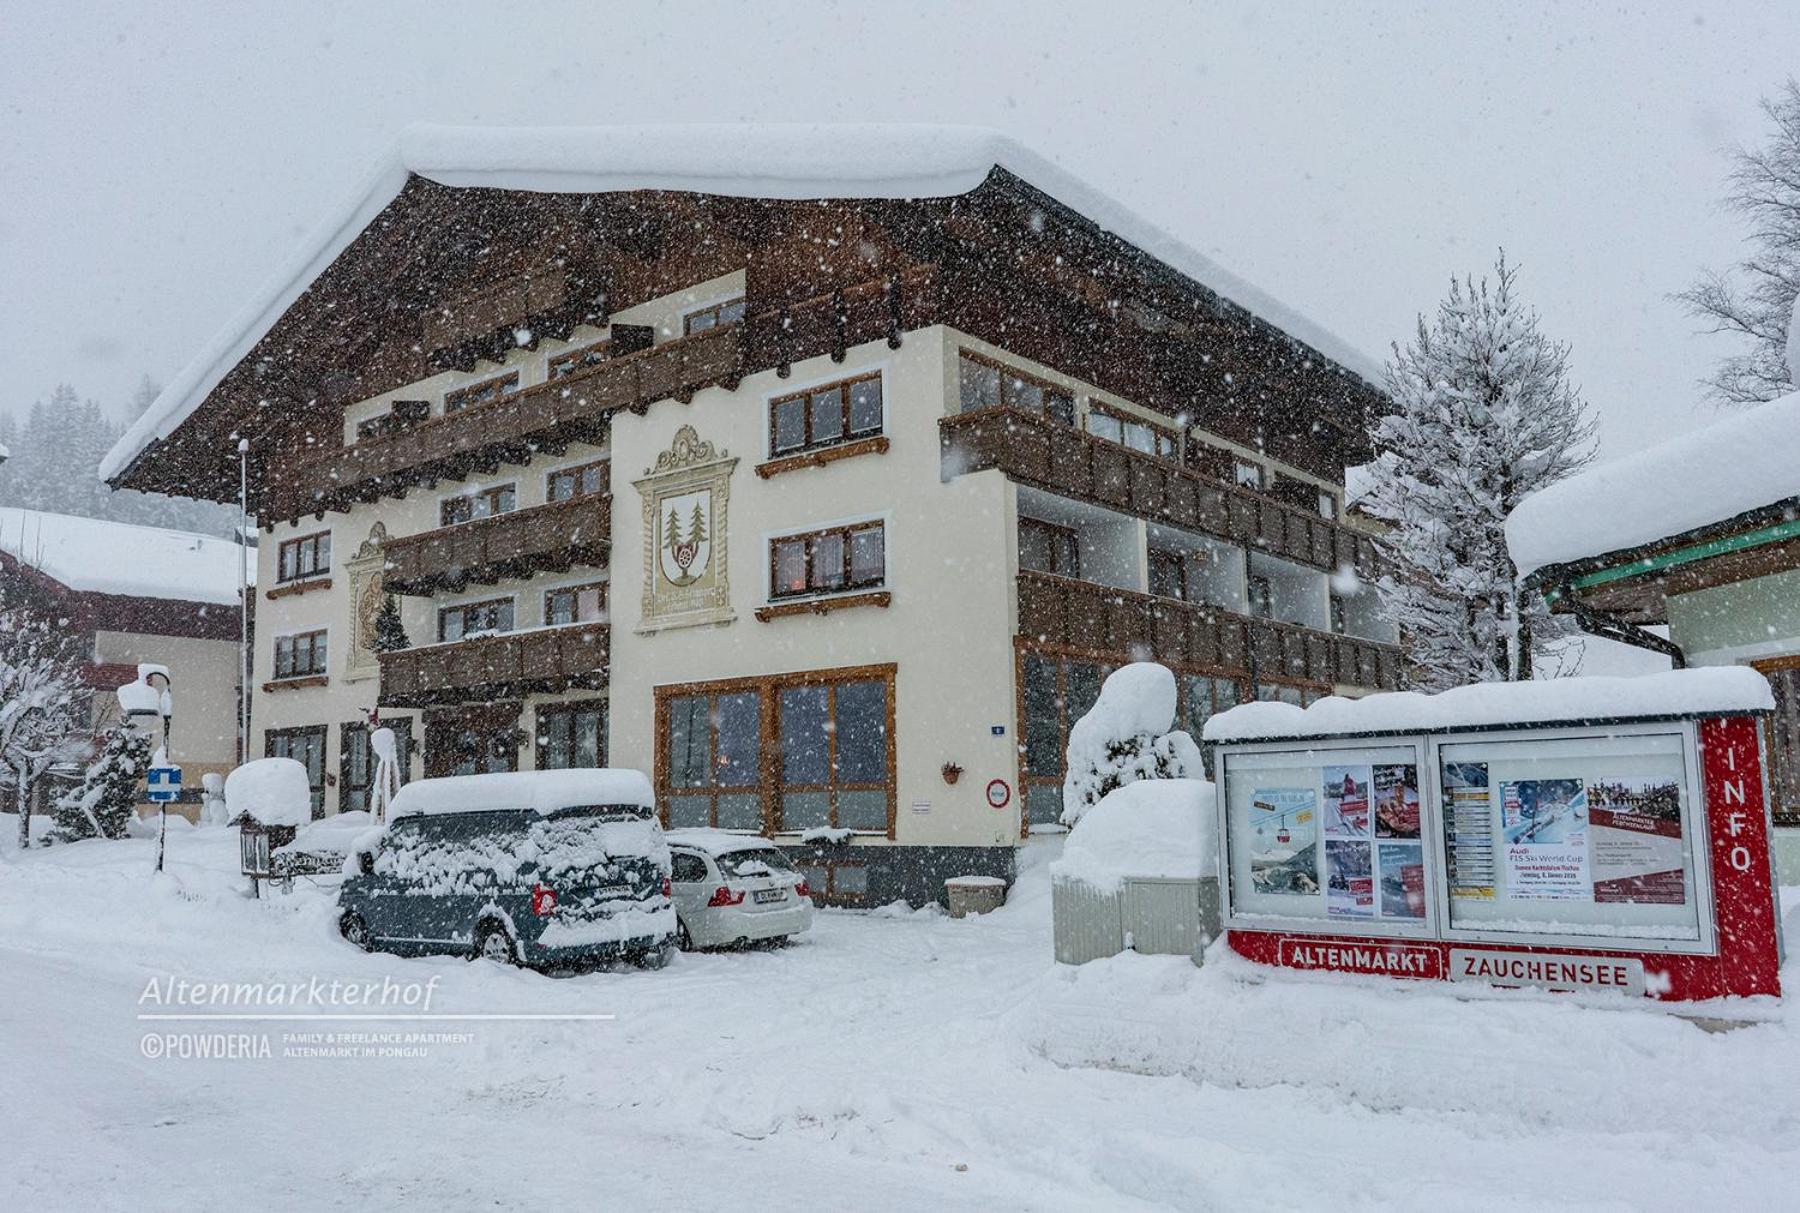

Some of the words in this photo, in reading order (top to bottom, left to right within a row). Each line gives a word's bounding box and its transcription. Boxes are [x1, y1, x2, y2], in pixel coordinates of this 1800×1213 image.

[1724, 747, 1751, 871] INFO
[1567, 855, 1583, 863] Cup
[1292, 946, 1428, 973] ALTENMARKT
[1463, 957, 1628, 986] ZAUCHENSEE
